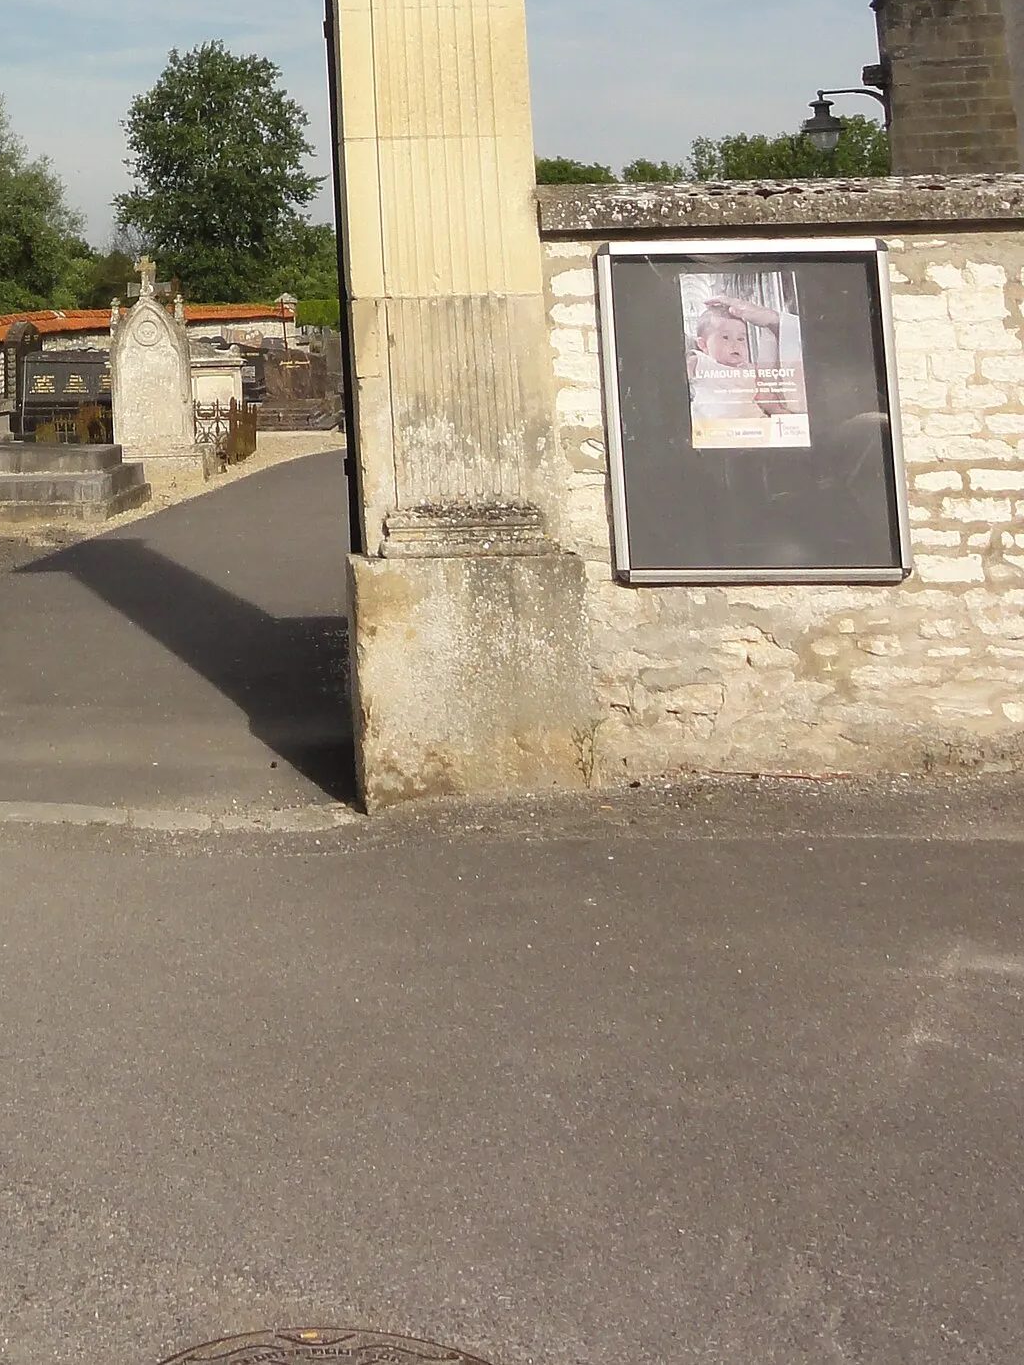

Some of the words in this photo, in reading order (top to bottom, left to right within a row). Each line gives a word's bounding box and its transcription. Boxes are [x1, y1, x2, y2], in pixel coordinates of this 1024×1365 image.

[695, 369, 740, 379] L'AMOUR
[742, 368, 756, 378] SE
[758, 368, 796, 380] REÇOIT
